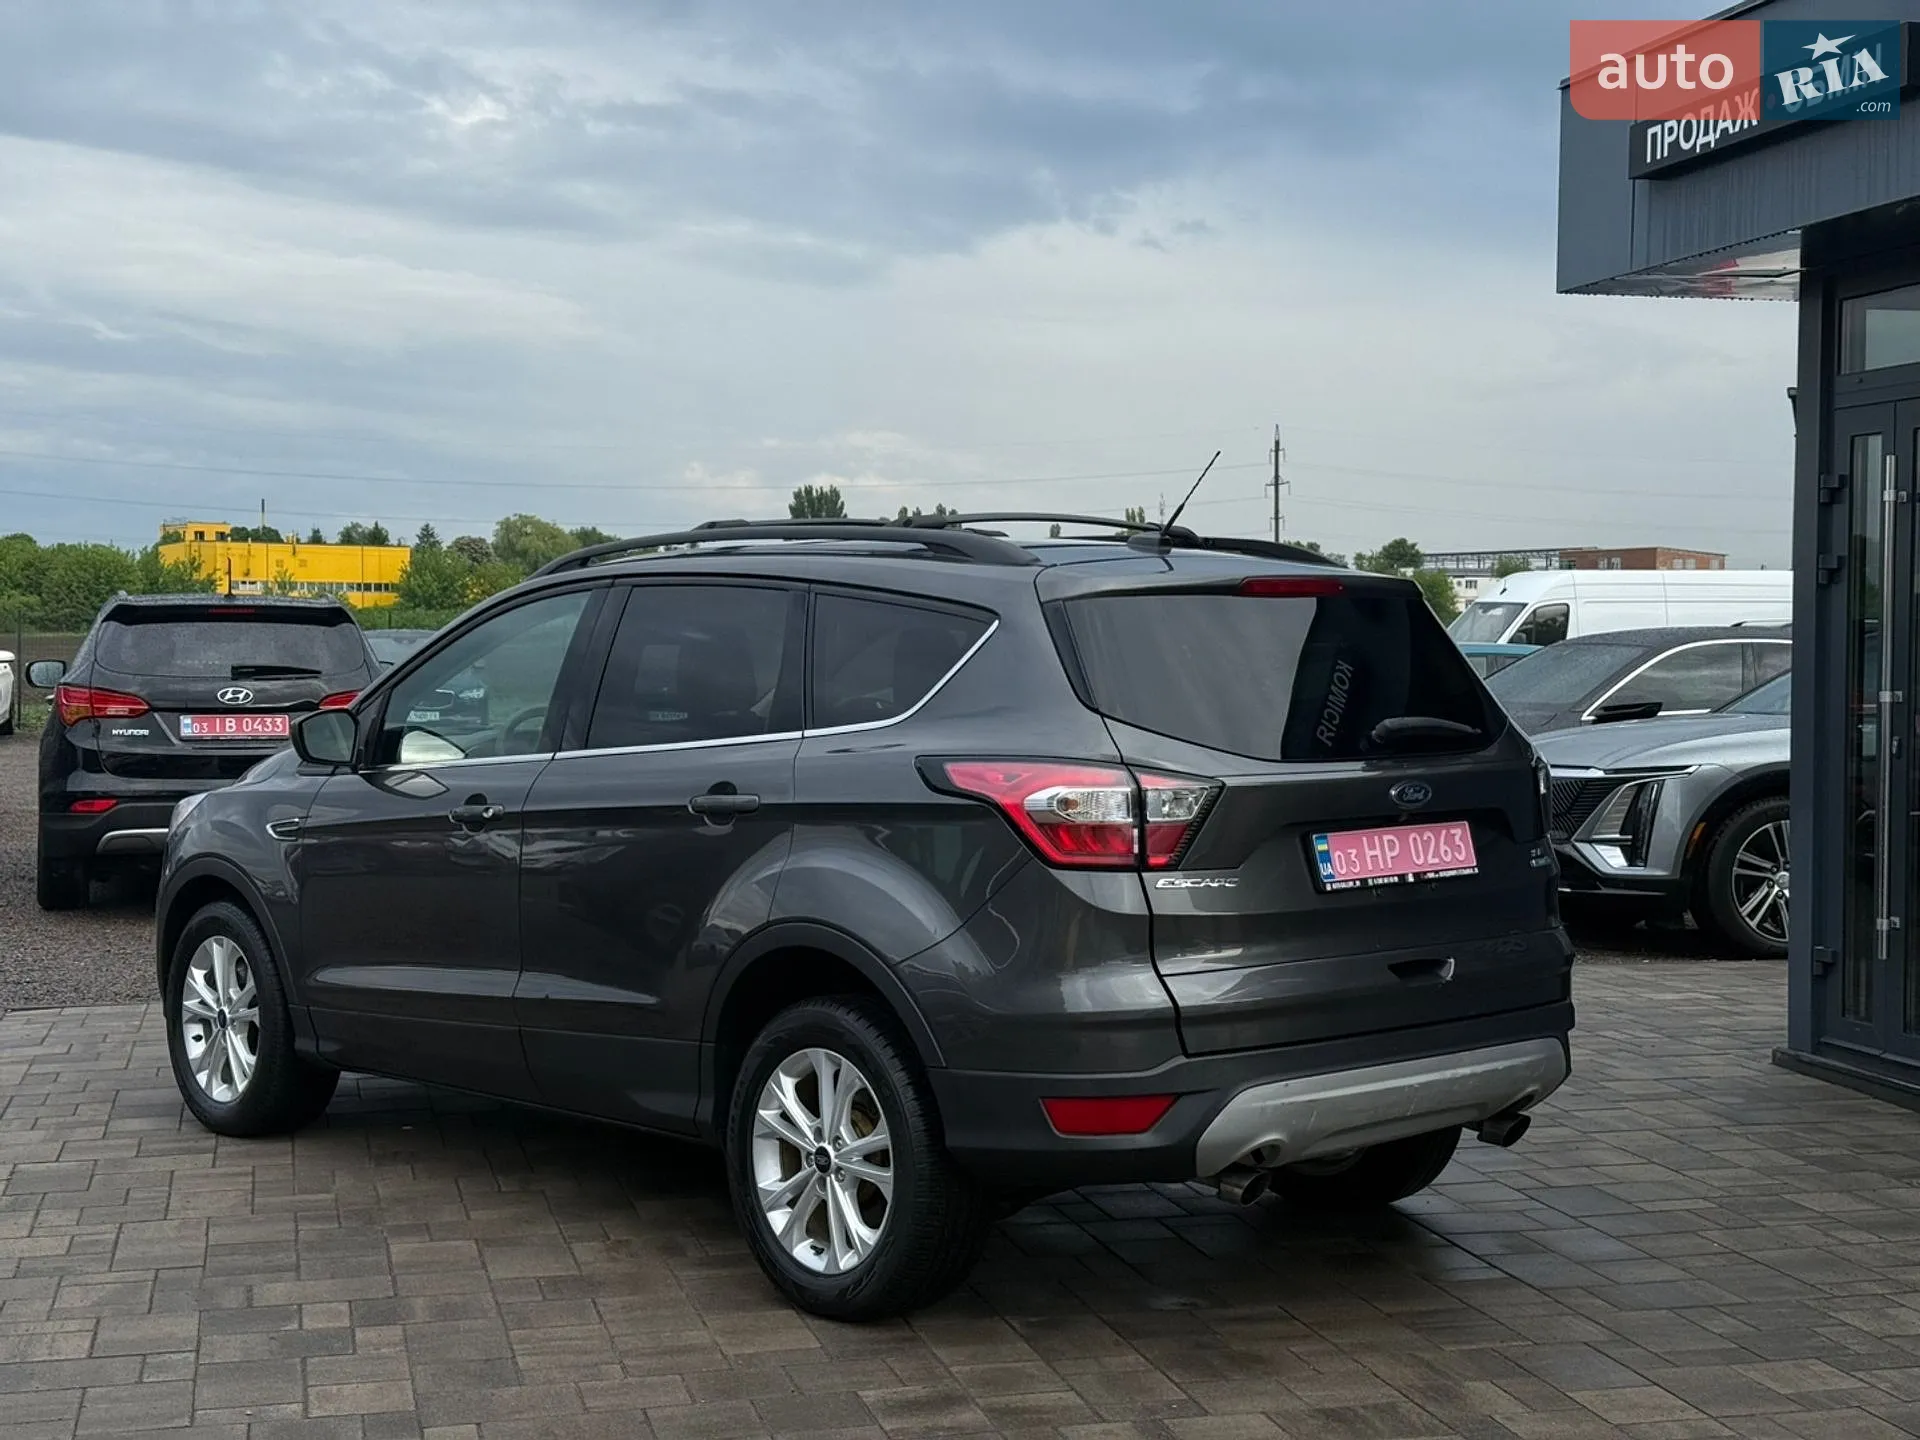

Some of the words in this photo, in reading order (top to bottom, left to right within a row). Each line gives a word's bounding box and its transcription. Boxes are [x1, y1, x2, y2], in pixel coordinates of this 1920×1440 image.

[1646, 86, 1760, 164] ПРОДАЖ
[193, 722, 209, 733] 03
[242, 717, 284, 733] 0433
[1334, 848, 1361, 875] 03
[1362, 834, 1400, 871] HP
[1408, 828, 1467, 867] 0263
[1319, 862, 1334, 876] UA
